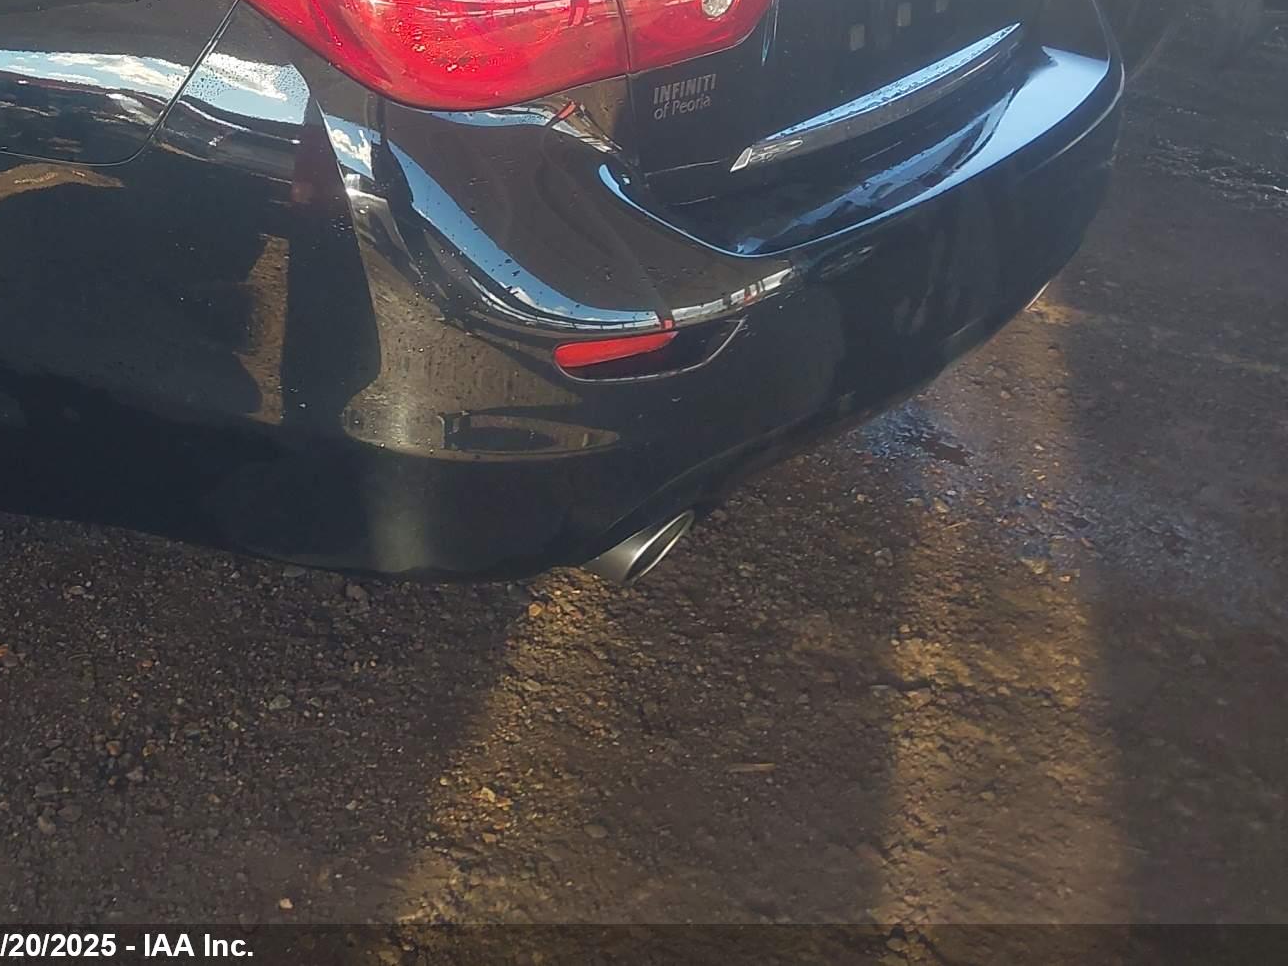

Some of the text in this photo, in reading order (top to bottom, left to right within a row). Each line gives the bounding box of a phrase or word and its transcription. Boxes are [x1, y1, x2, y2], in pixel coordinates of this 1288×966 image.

[653, 73, 717, 105] INFINITI
[654, 93, 711, 120] of Peoria
